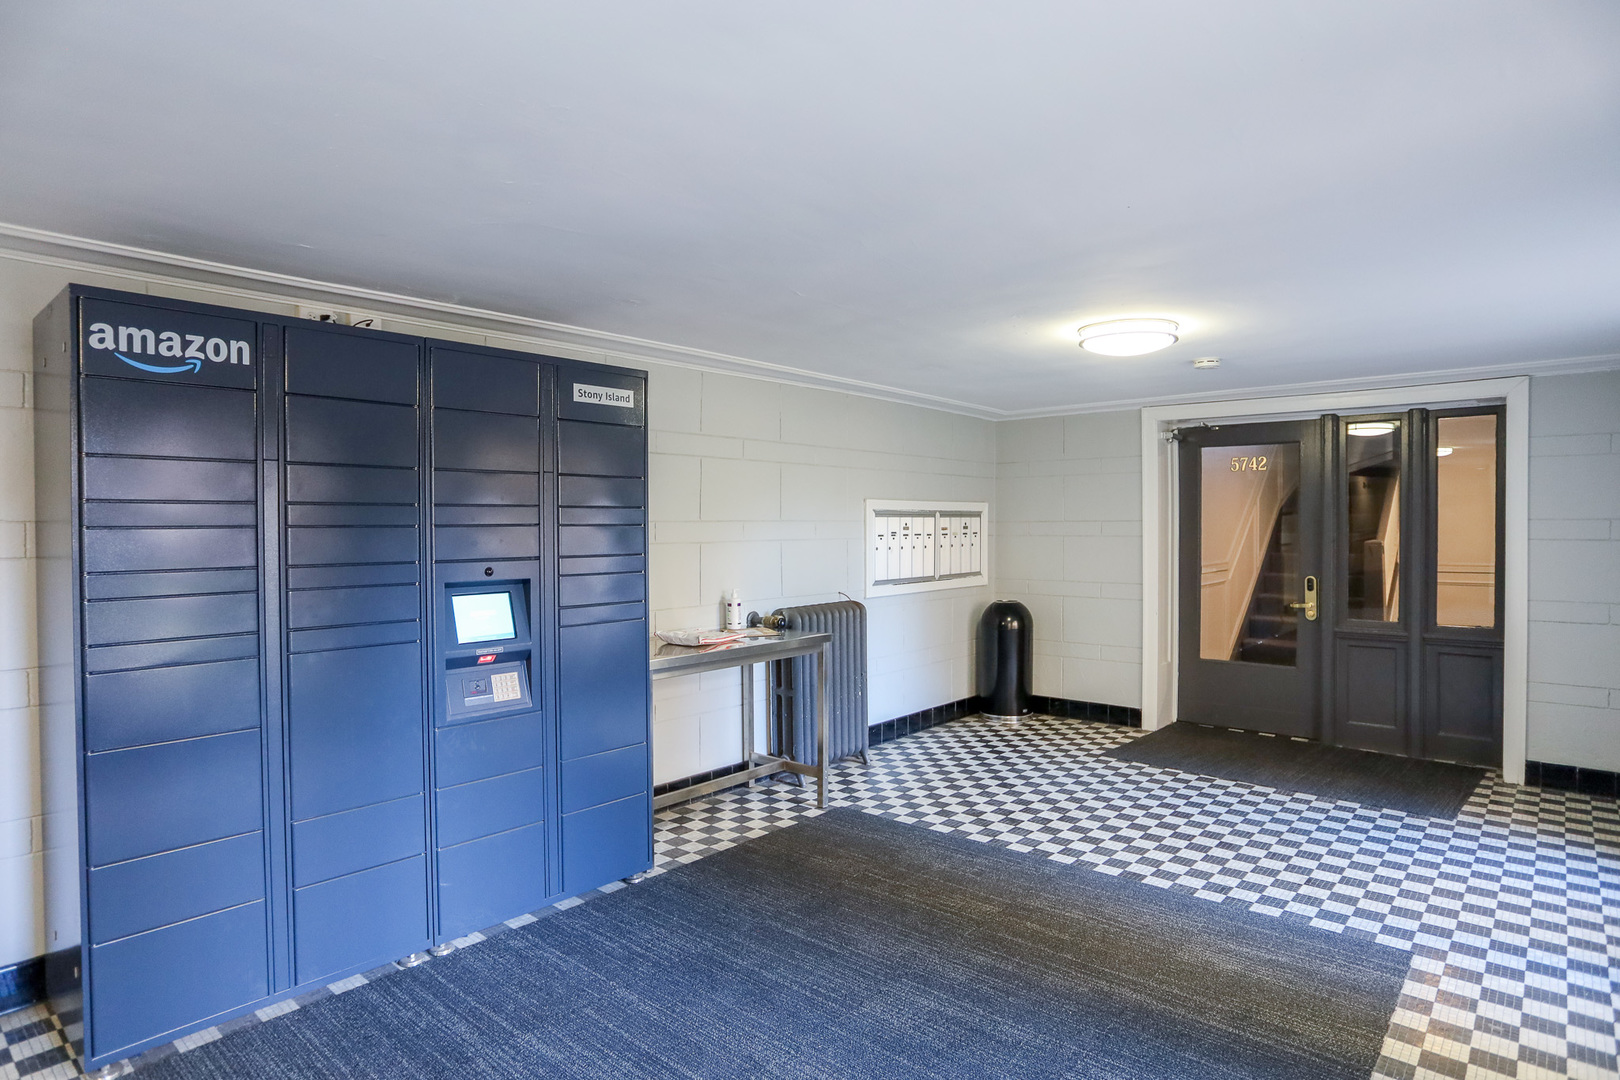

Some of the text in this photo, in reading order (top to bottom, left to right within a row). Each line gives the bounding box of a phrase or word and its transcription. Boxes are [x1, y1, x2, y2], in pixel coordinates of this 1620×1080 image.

[88, 322, 250, 365] amazon
[577, 388, 631, 403] Stony Island
[1230, 456, 1267, 472] 5742
